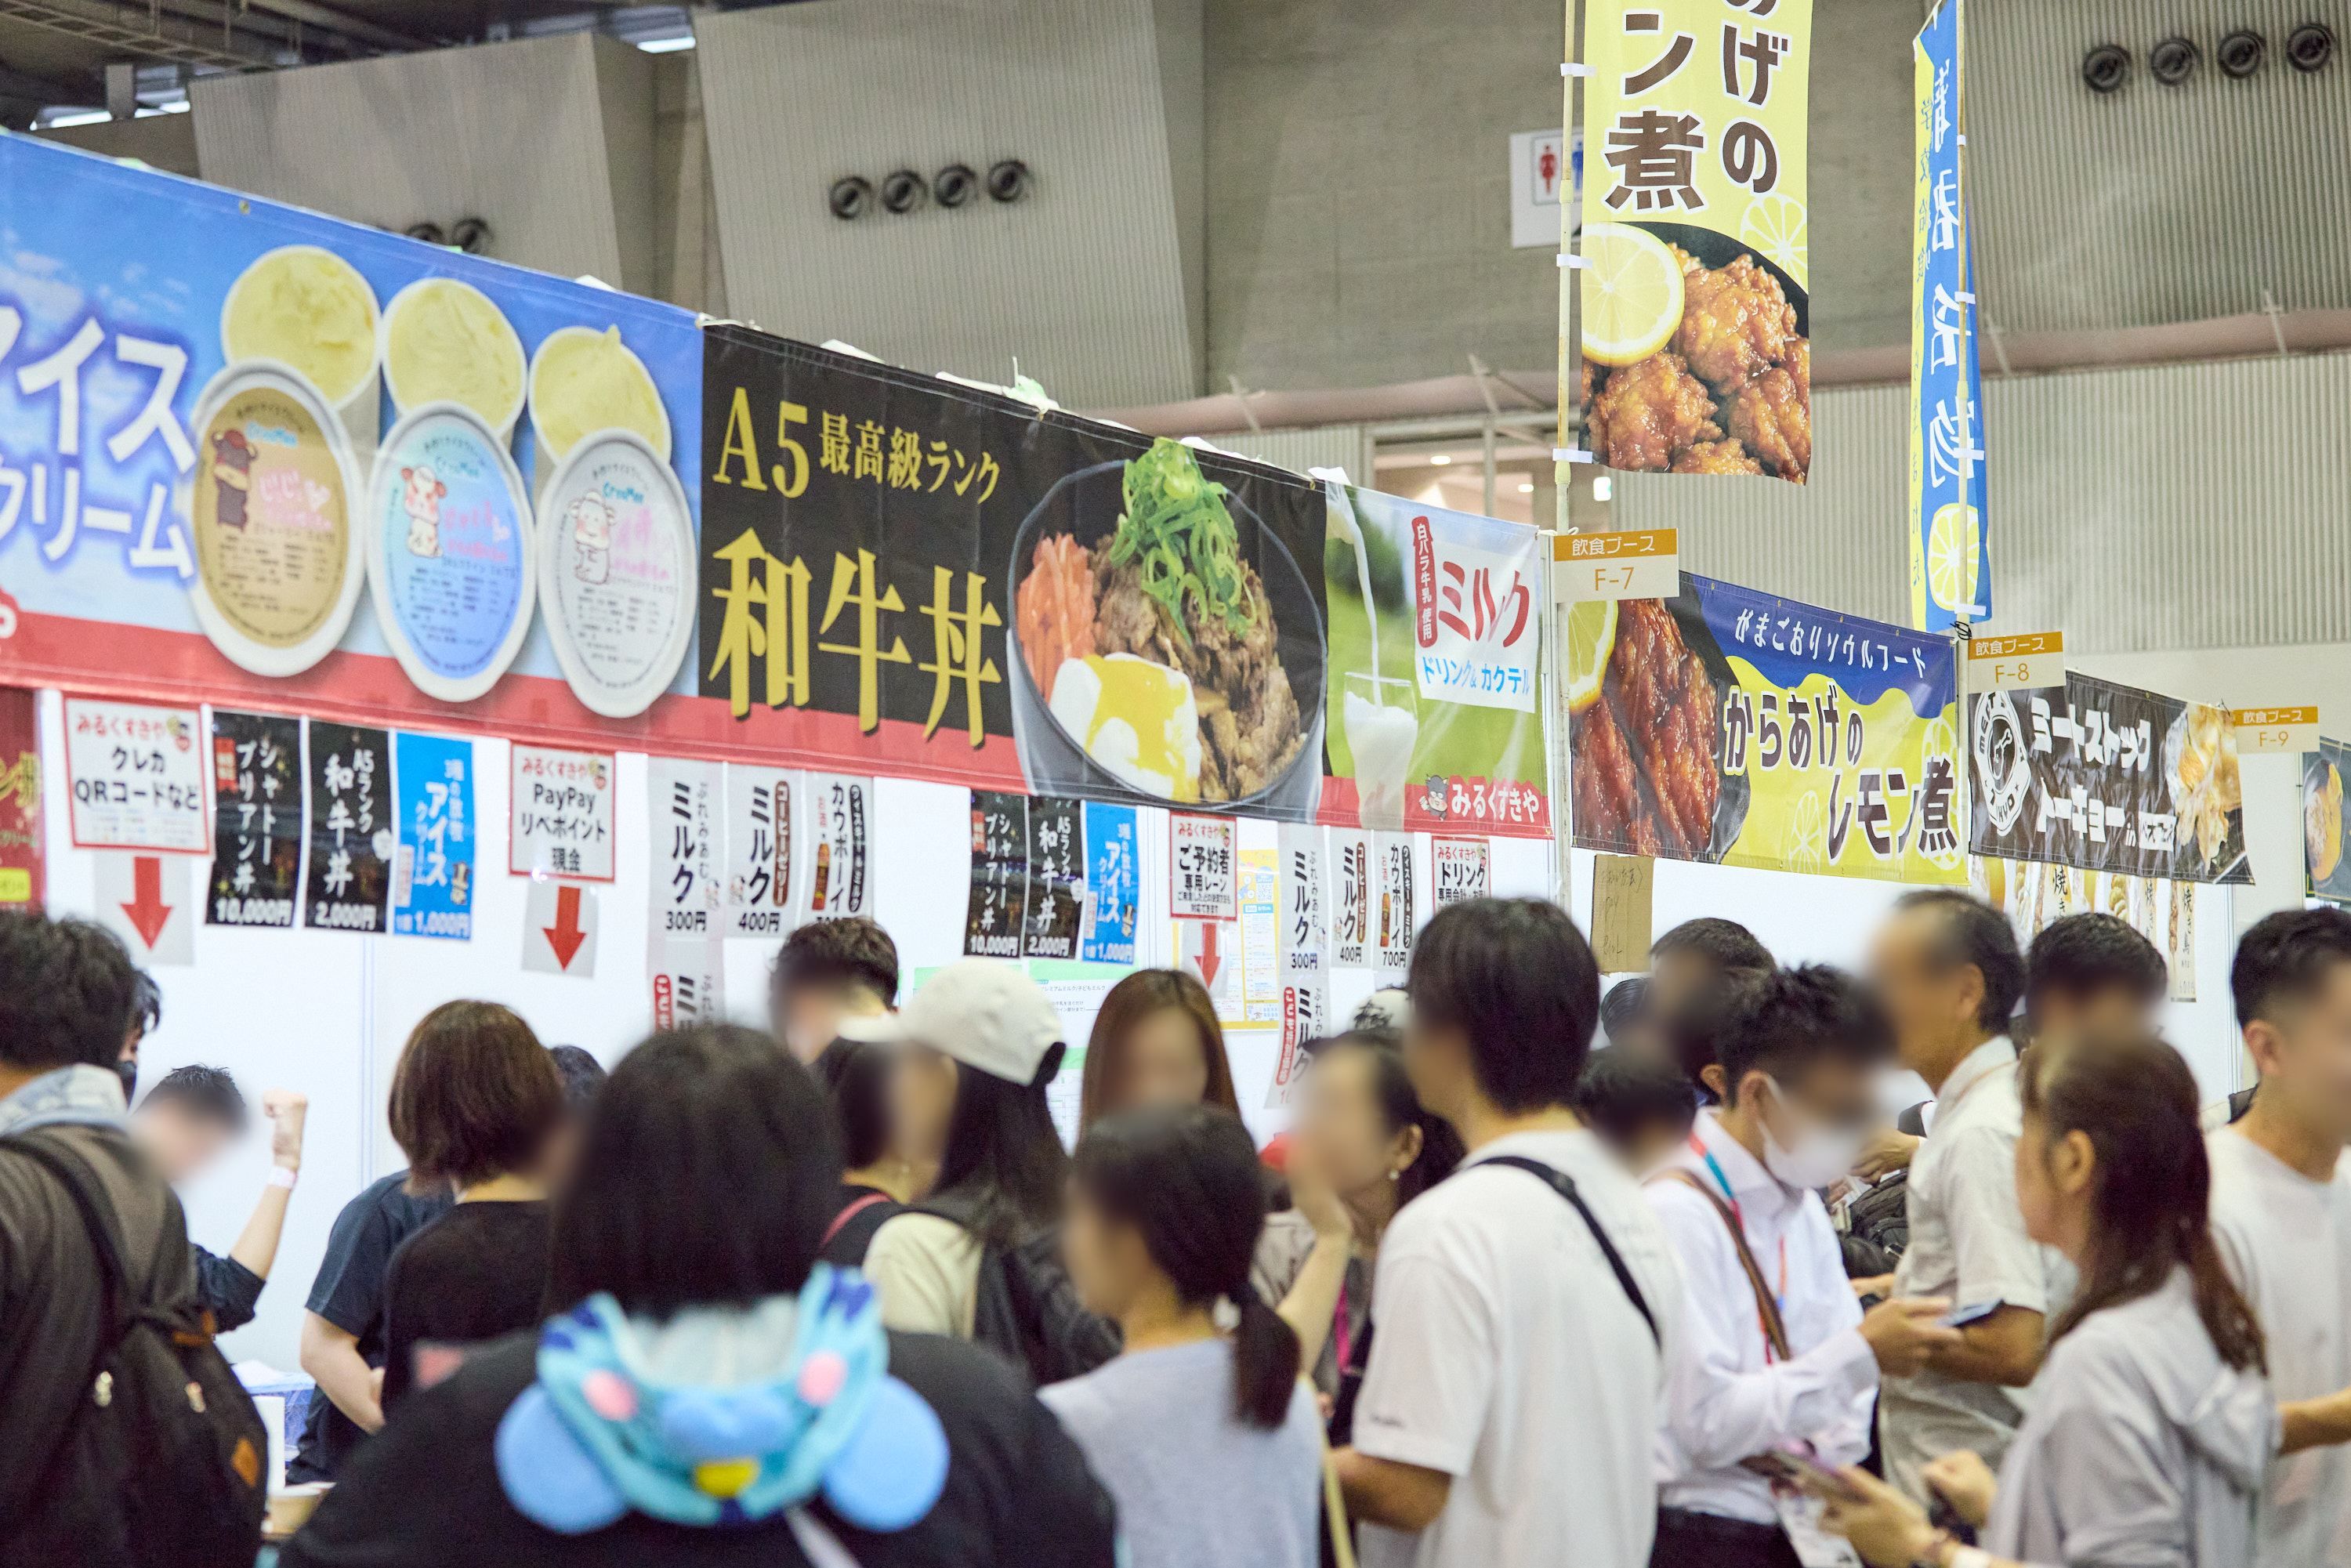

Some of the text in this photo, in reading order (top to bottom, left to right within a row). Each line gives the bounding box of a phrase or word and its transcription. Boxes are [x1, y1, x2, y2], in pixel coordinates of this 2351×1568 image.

[1605, 14, 1704, 211] ン煮
[1723, 0, 1788, 194] げの
[0, 306, 197, 473] イス
[1572, 535, 1655, 557] 飲食ブース
[1438, 561, 1530, 648] ミルク
[1594, 567, 1635, 592] F-7
[708, 527, 1002, 747] 和牛丼
[1735, 607, 1926, 678] がまごおりソウルフード
[1975, 636, 2045, 656] 飲食ブース
[1994, 664, 2030, 683] F-8
[77, 714, 167, 741] みるくすきや
[1726, 684, 1864, 768] からあげの
[2031, 697, 2151, 772] ミートストック
[2242, 709, 2303, 724] 飲食ブース
[2259, 730, 2290, 748] F-9
[112, 746, 165, 773] クレカ
[522, 758, 588, 780] みるくすきや
[74, 780, 199, 810] QRコードなど
[234, 739, 258, 896] ブリアン丼
[259, 739, 280, 866] シャトー
[353, 748, 375, 834] A5ランク
[534, 783, 596, 815] PayPay
[1451, 780, 1539, 824] みるくすきや
[1829, 756, 1958, 860] レモン煮
[2037, 777, 2126, 843] トーキョー
[2125, 822, 2136, 847] in
[323, 752, 356, 898] 和牛丼
[425, 780, 449, 887] アイス
[672, 782, 695, 904] ミルク
[748, 786, 773, 905] ミルク
[831, 782, 848, 912] カウボーイ
[1057, 815, 1071, 882] A5ランク
[1178, 823, 1219, 839] みるくすきや
[552, 847, 581, 872] 現金
[980, 812, 998, 931] ブリアン丼
[999, 813, 1011, 909] シャトー
[1036, 820, 1060, 932] 和牛丼
[1179, 843, 1230, 875] ご予約者
[1437, 846, 1476, 861] みるくすきや
[1442, 861, 1486, 888] ドリンク
[1104, 841, 1121, 924] アイス
[1184, 874, 1227, 892] 専用レーン
[1294, 851, 1310, 949] ミルク
[1343, 846, 1357, 942] ミルク
[1357, 847, 1366, 942] コーヒーゼリー
[1390, 844, 1402, 948] カウボーイ
[2052, 865, 2068, 920] 焼き
[216, 898, 294, 925] 10,000円
[314, 901, 377, 931] 2,000円
[665, 911, 708, 932] 300円
[737, 912, 781, 932] 400円
[970, 935, 1019, 956] 10,000円
[1028, 936, 1070, 957] 2,000円
[1291, 953, 1318, 970] 300円
[1339, 947, 1363, 963] 400円
[1382, 951, 1407, 968] 700円
